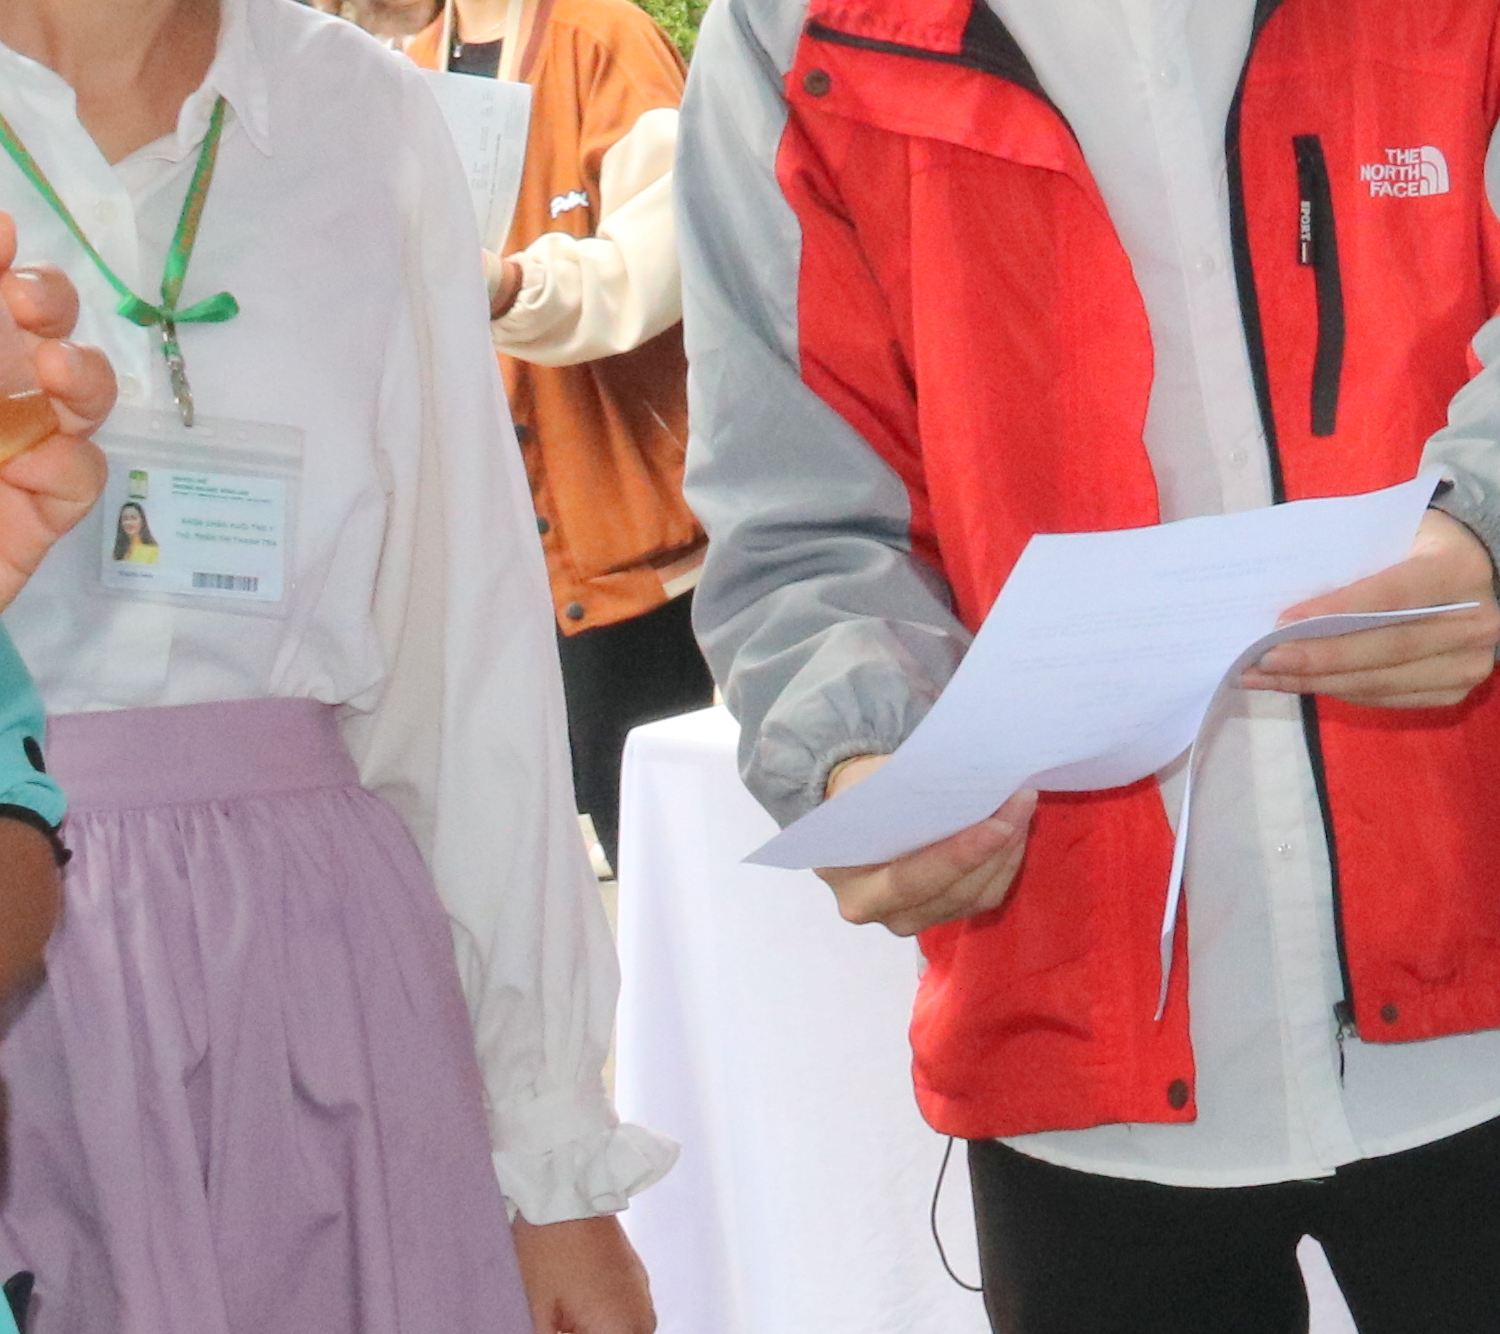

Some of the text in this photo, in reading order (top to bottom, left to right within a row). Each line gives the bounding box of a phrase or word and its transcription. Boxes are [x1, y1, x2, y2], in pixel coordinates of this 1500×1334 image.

[1385, 148, 1421, 165] THE
[1360, 164, 1421, 182] NORTH
[1370, 181, 1420, 198] FACE
[1300, 200, 1311, 242] SPORT
